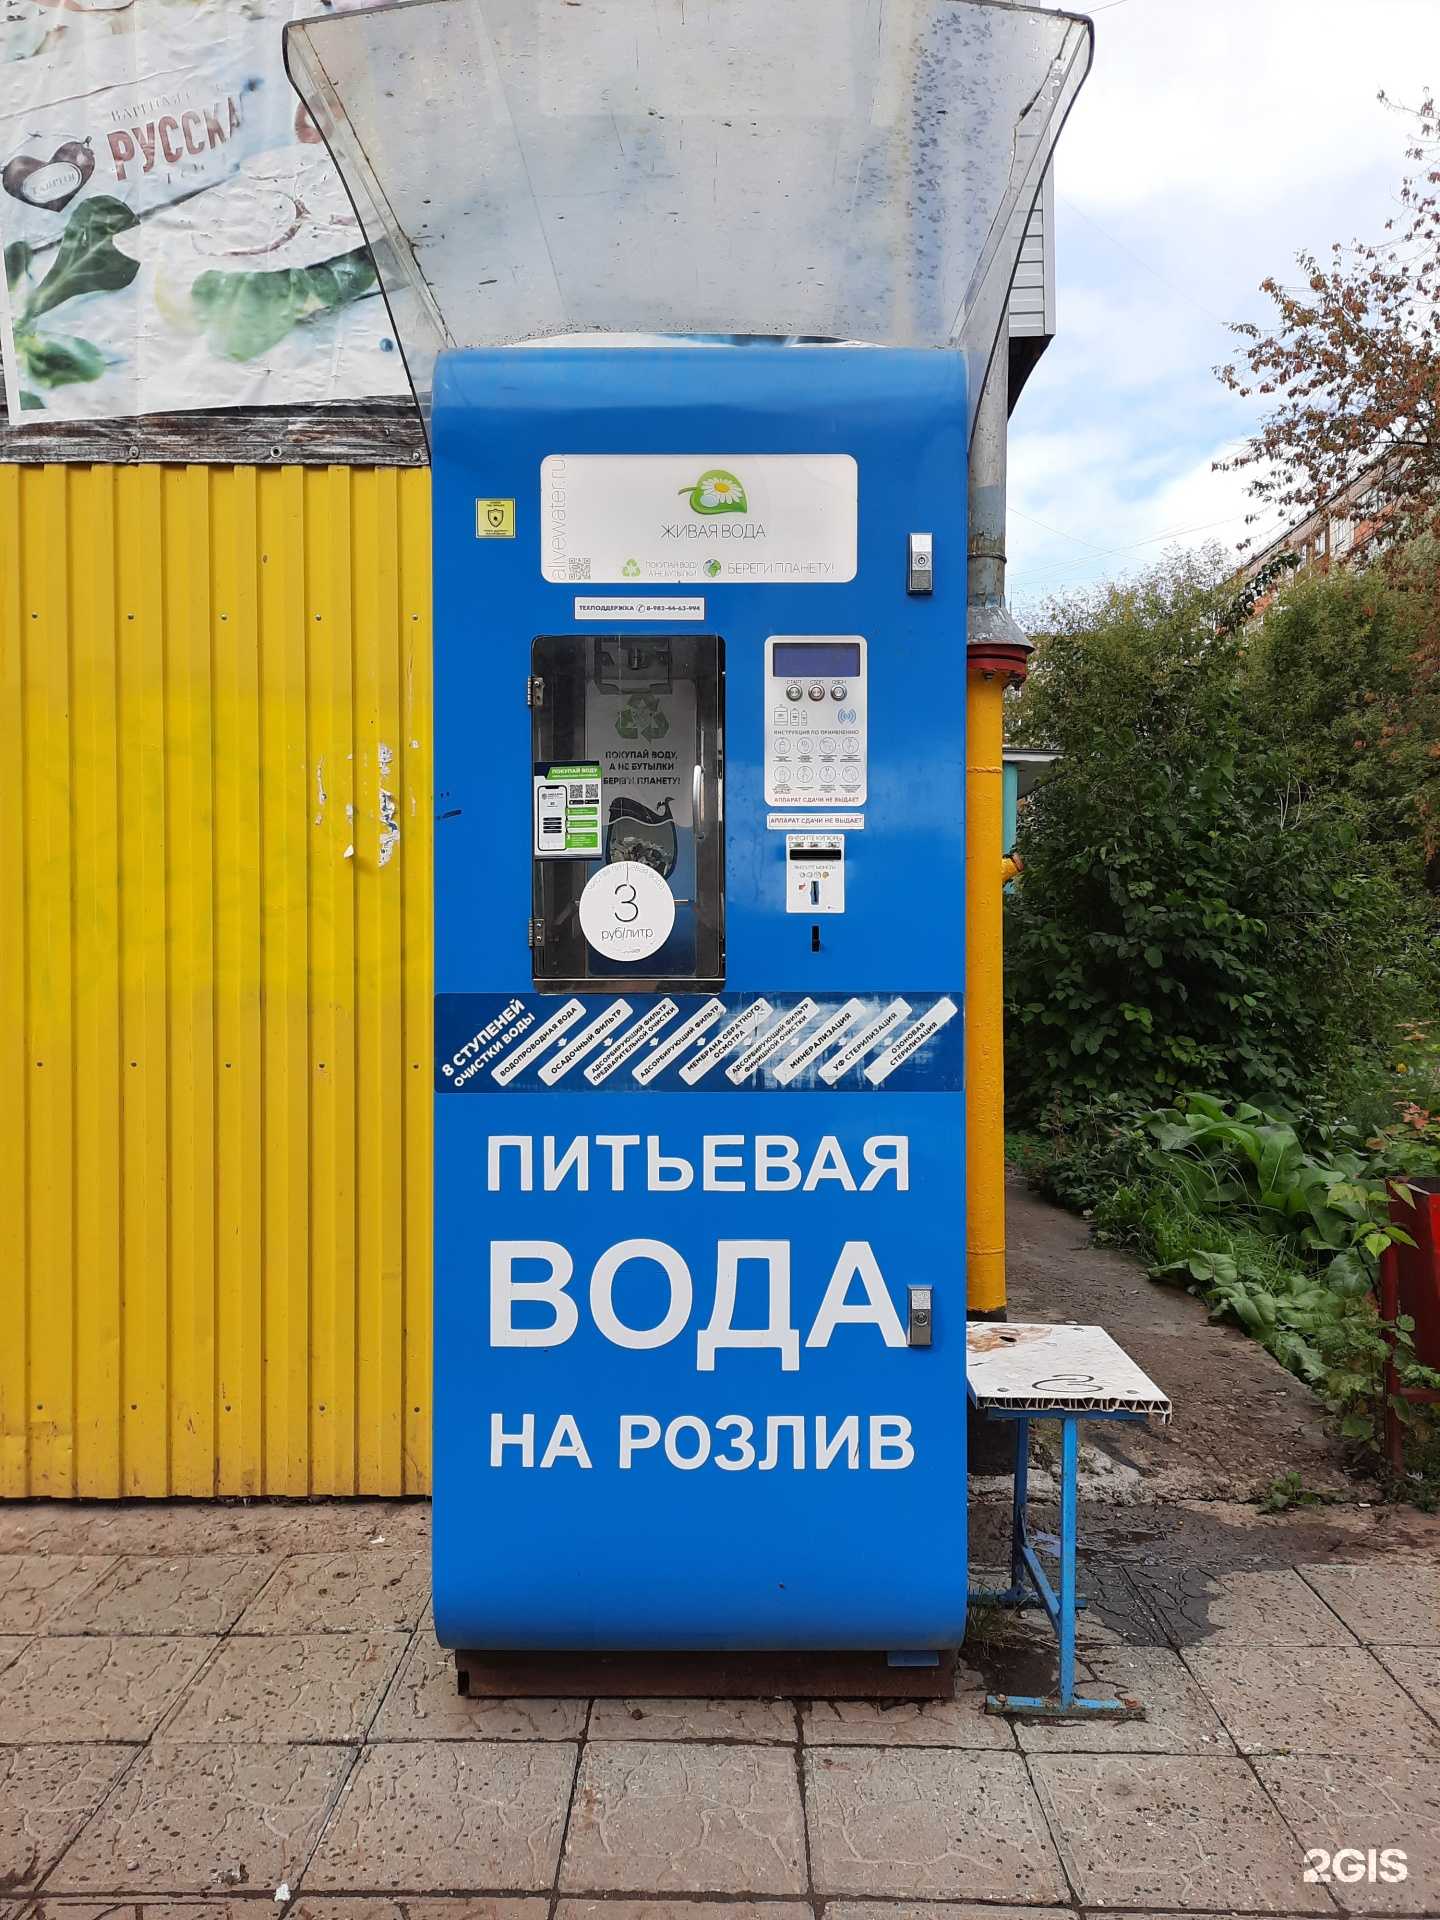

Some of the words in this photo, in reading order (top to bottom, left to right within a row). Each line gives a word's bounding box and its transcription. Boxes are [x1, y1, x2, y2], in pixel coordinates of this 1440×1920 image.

[547, 456, 567, 580] alivewater.ru
[661, 523, 718, 539] ЖИВАЯ
[721, 523, 766, 539] ВОДА
[727, 562, 773, 575] БЕРЕГИ
[775, 562, 834, 575] ПЛАНЕТУ!
[606, 749, 649, 759] ПОКУПАЙ
[801, 817, 823, 825] СДАЧИ
[835, 817, 863, 825] ВЫДАЕТ
[614, 883, 639, 922] 3
[601, 926, 654, 941] руб/литр
[442, 1063, 455, 1077] 8
[453, 998, 526, 1066] СТУПЕНЕЙ
[454, 1042, 504, 1087] ОЧИСТКИ
[501, 1012, 536, 1044] ВОДЫ
[500, 1023, 558, 1077] ВОДОПРОВОДНАЯ
[557, 1007, 578, 1025] ВОДА
[551, 1033, 595, 1074] ОСАДОЧНЫЙ
[594, 1009, 622, 1035] ФИЛЬТР
[591, 1024, 645, 1073] АДСОРБИРУЮЩИЙ
[643, 1004, 667, 1026] ФИЛЬТР
[592, 1030, 649, 1081] ПРЕДВАРИТЕЛЬНОЙ
[648, 1007, 675, 1032] ОЧИСТКИ
[640, 1026, 695, 1078] АДСОРБИРУЮЩИЙ
[694, 1005, 720, 1028] ФИЛЬТР
[687, 1039, 724, 1071] МЕМБРАНА
[722, 1004, 761, 1040] ОБРАТНОГО
[713, 1030, 746, 1059] ОСМОТРА
[732, 1024, 787, 1073] АДСОРБИРУЮЩИЙ
[785, 1003, 809, 1025] ФИЛЬТР
[744, 1039, 780, 1072] ФИНИШНОЙ
[779, 1015, 808, 1041] ОЧИСТКИ
[789, 1012, 852, 1069] МИНЕРАЛИЗАЦИЯ
[832, 1058, 846, 1072] УФ
[844, 1012, 898, 1061] СТЕРИЛИЗАЦИЯ
[890, 1022, 938, 1066] СТЕРИЛИЗАЦИЯ
[891, 1022, 926, 1054] ОЗОНОВАЯ
[487, 1134, 910, 1192] ПИТЬЕВАЯ
[489, 1238, 909, 1371] ВОДА
[490, 1412, 593, 1469] НА
[619, 1414, 915, 1471] РОЗЛИВ
